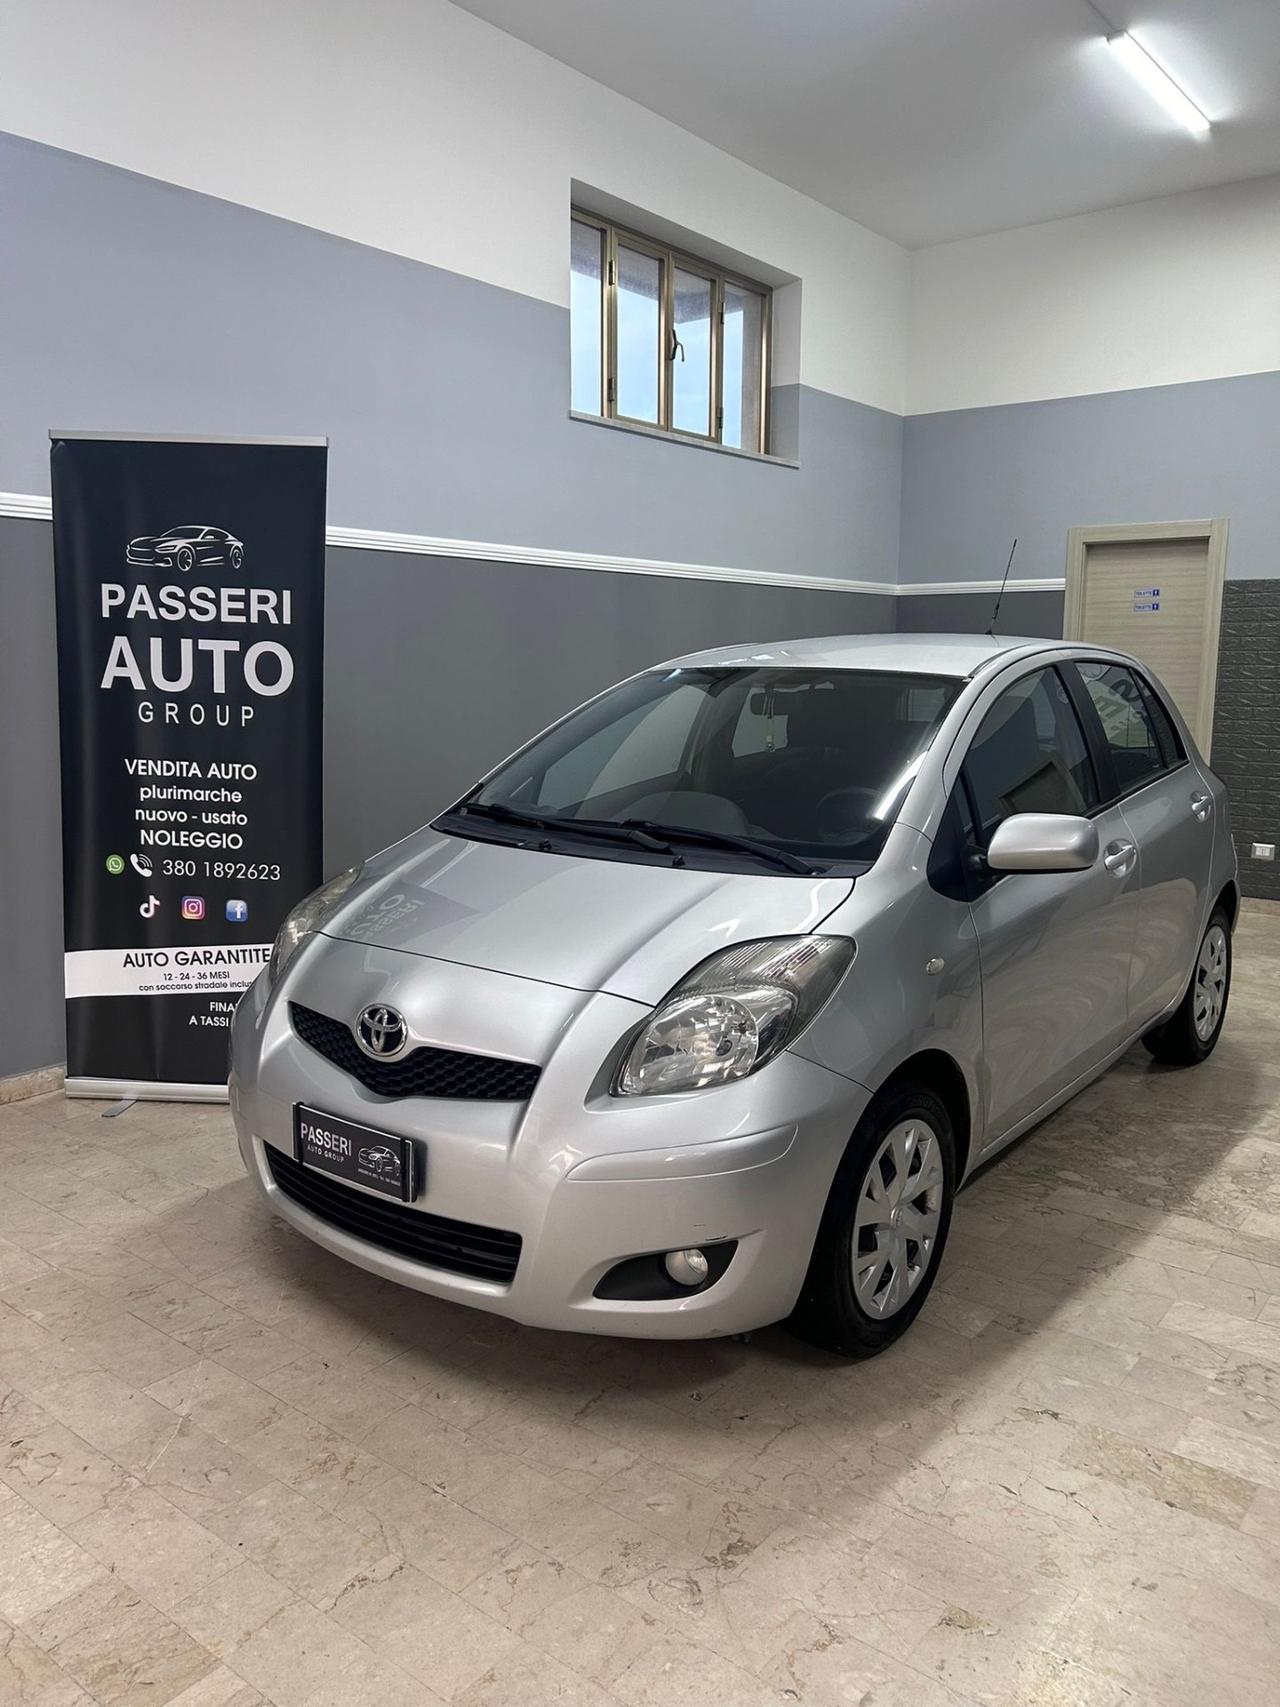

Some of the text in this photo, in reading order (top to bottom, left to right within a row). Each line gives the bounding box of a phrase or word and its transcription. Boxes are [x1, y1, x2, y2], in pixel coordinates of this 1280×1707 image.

[101, 583, 292, 625] PASSERI
[100, 635, 295, 697] AUTO
[138, 702, 255, 727] GROUP
[124, 758, 257, 780] VENDITA AUTO
[139, 785, 242, 803] plurimarche
[135, 808, 187, 823] nuovo
[202, 811, 248, 826] usato
[140, 829, 243, 850] NOLEGGIO
[162, 859, 281, 881] 380 1892623
[123, 948, 271, 968] AUTO GARANTITE
[155, 982, 193, 991] soccorso
[194, 980, 228, 989] stradale
[163, 973, 173, 981] 12
[179, 972, 190, 981] 24
[197, 971, 208, 980] 36
[209, 971, 230, 980] MESI
[209, 1002, 237, 1012] FINA
[189, 1015, 229, 1027] A TASSI
[300, 1122, 352, 1156] PASSERI
[307, 1143, 345, 1163] AUTO GROUP
